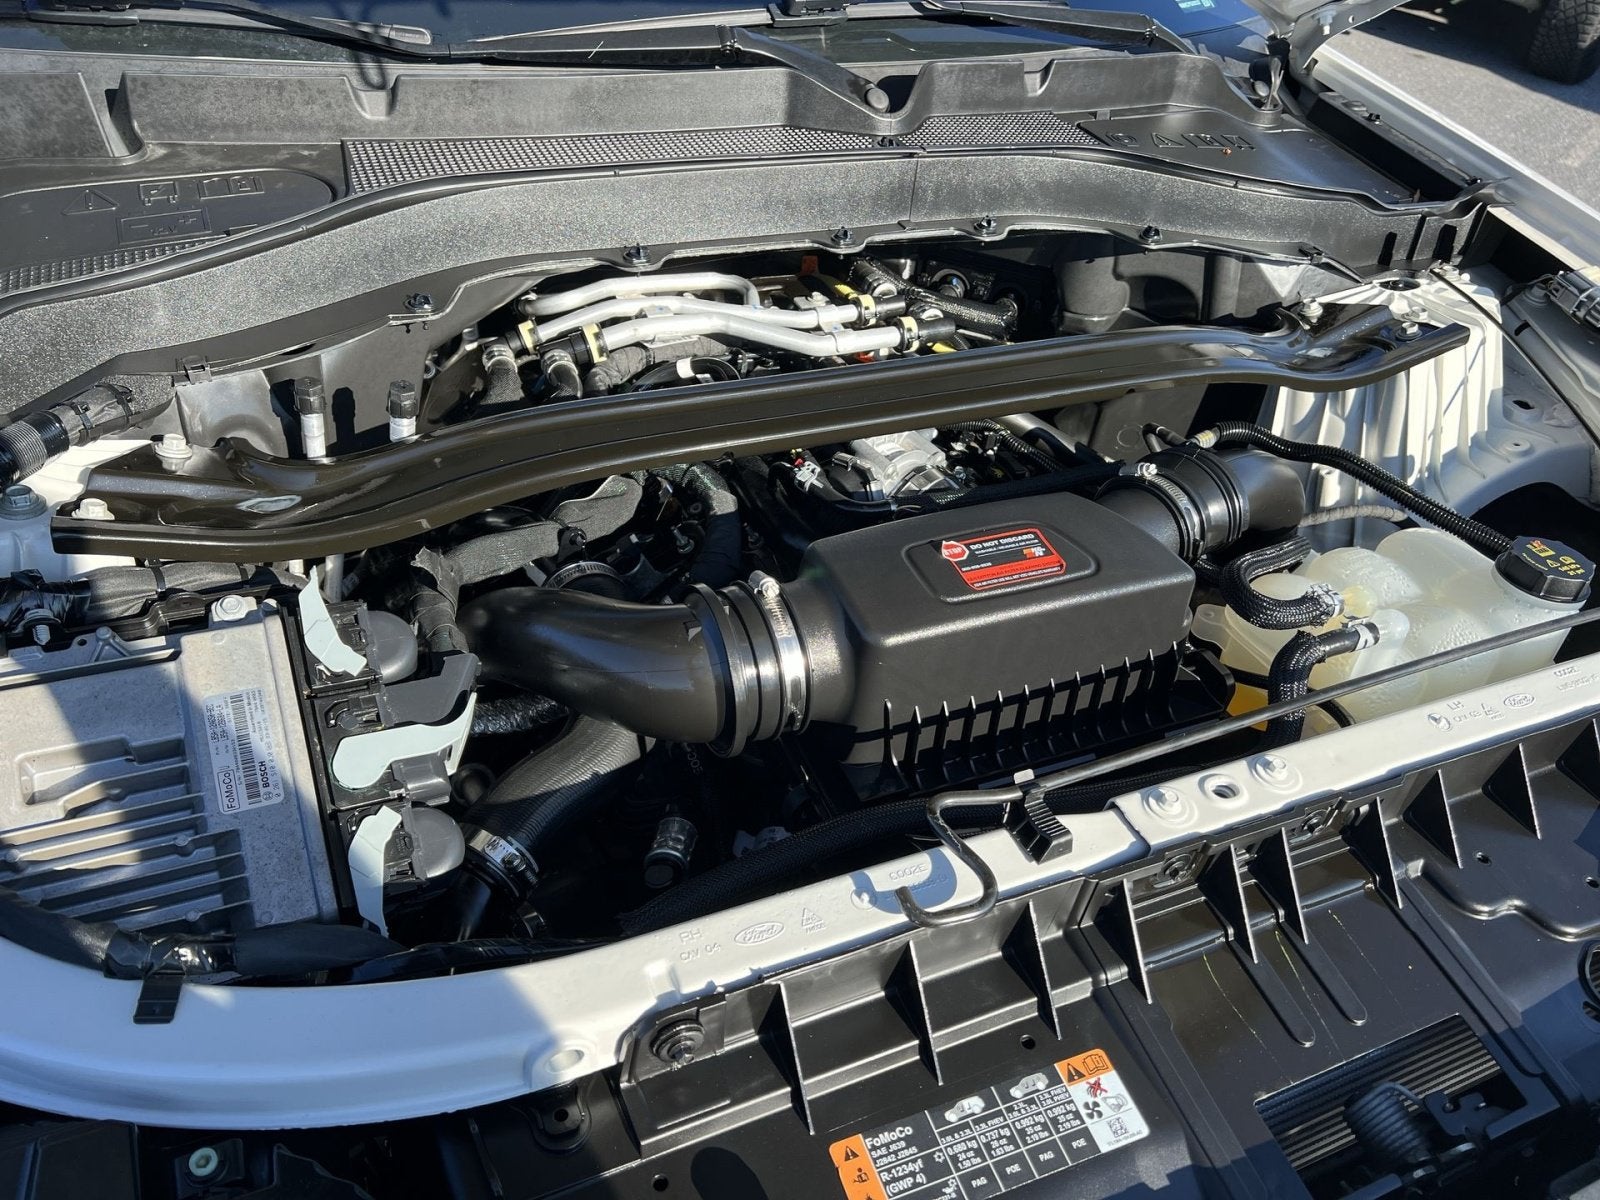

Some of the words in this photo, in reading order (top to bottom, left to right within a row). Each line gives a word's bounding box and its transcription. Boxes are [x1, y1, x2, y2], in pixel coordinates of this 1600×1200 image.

[982, 540, 999, 548] NOT
[999, 533, 1035, 544] DISCARD
[944, 547, 963, 556] STOP
[258, 761, 270, 788] BOSCH
[223, 772, 236, 809] FoMoCo
[740, 923, 780, 944] Ford
[1065, 1103, 1076, 1111] kg
[1015, 1117, 1034, 1129] 0.992
[865, 1127, 913, 1149] FoMoCo
[980, 1130, 998, 1143] 0.737
[999, 1128, 1010, 1136] kg
[871, 1147, 888, 1158] SAE
[889, 1141, 905, 1152] J639
[966, 1140, 978, 1148] kg
[1072, 1138, 1086, 1149] POE
[876, 1154, 896, 1167] J2842
[897, 1146, 917, 1159] J2845
[958, 1153, 966, 1161] 24
[971, 1157, 981, 1165] lbs
[1039, 1151, 1054, 1161] PAG
[880, 1159, 923, 1182] R-1234yf
[1006, 1164, 1021, 1174] POE
[886, 1177, 917, 1196] (GWP
[916, 1173, 926, 1184] 4)
[971, 1177, 987, 1187] PAG
